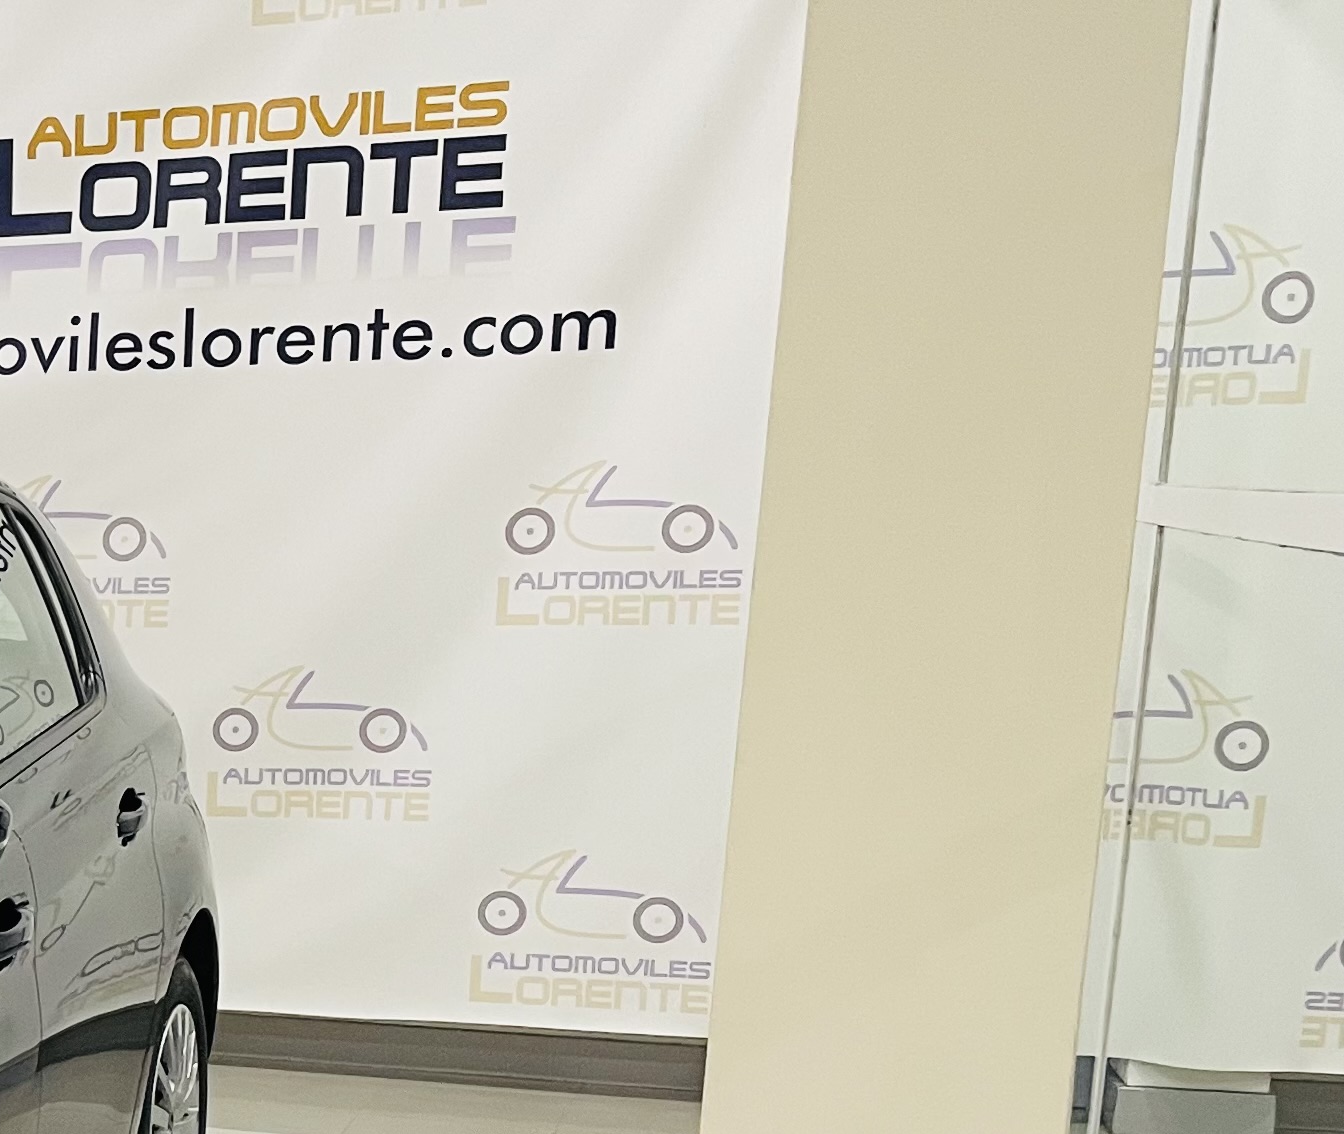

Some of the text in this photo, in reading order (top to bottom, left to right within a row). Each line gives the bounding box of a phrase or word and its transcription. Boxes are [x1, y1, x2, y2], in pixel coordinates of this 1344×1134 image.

[28, 81, 509, 160] AUTOMOVILES
[496, 576, 740, 627] LORENTE
[514, 569, 743, 591] AUTOMOVILES
[206, 771, 430, 822] LORENTE
[223, 767, 432, 788] AUTOMOVILES
[469, 954, 709, 1014] LORENTE
[488, 951, 712, 980] AUTOMOVILES
